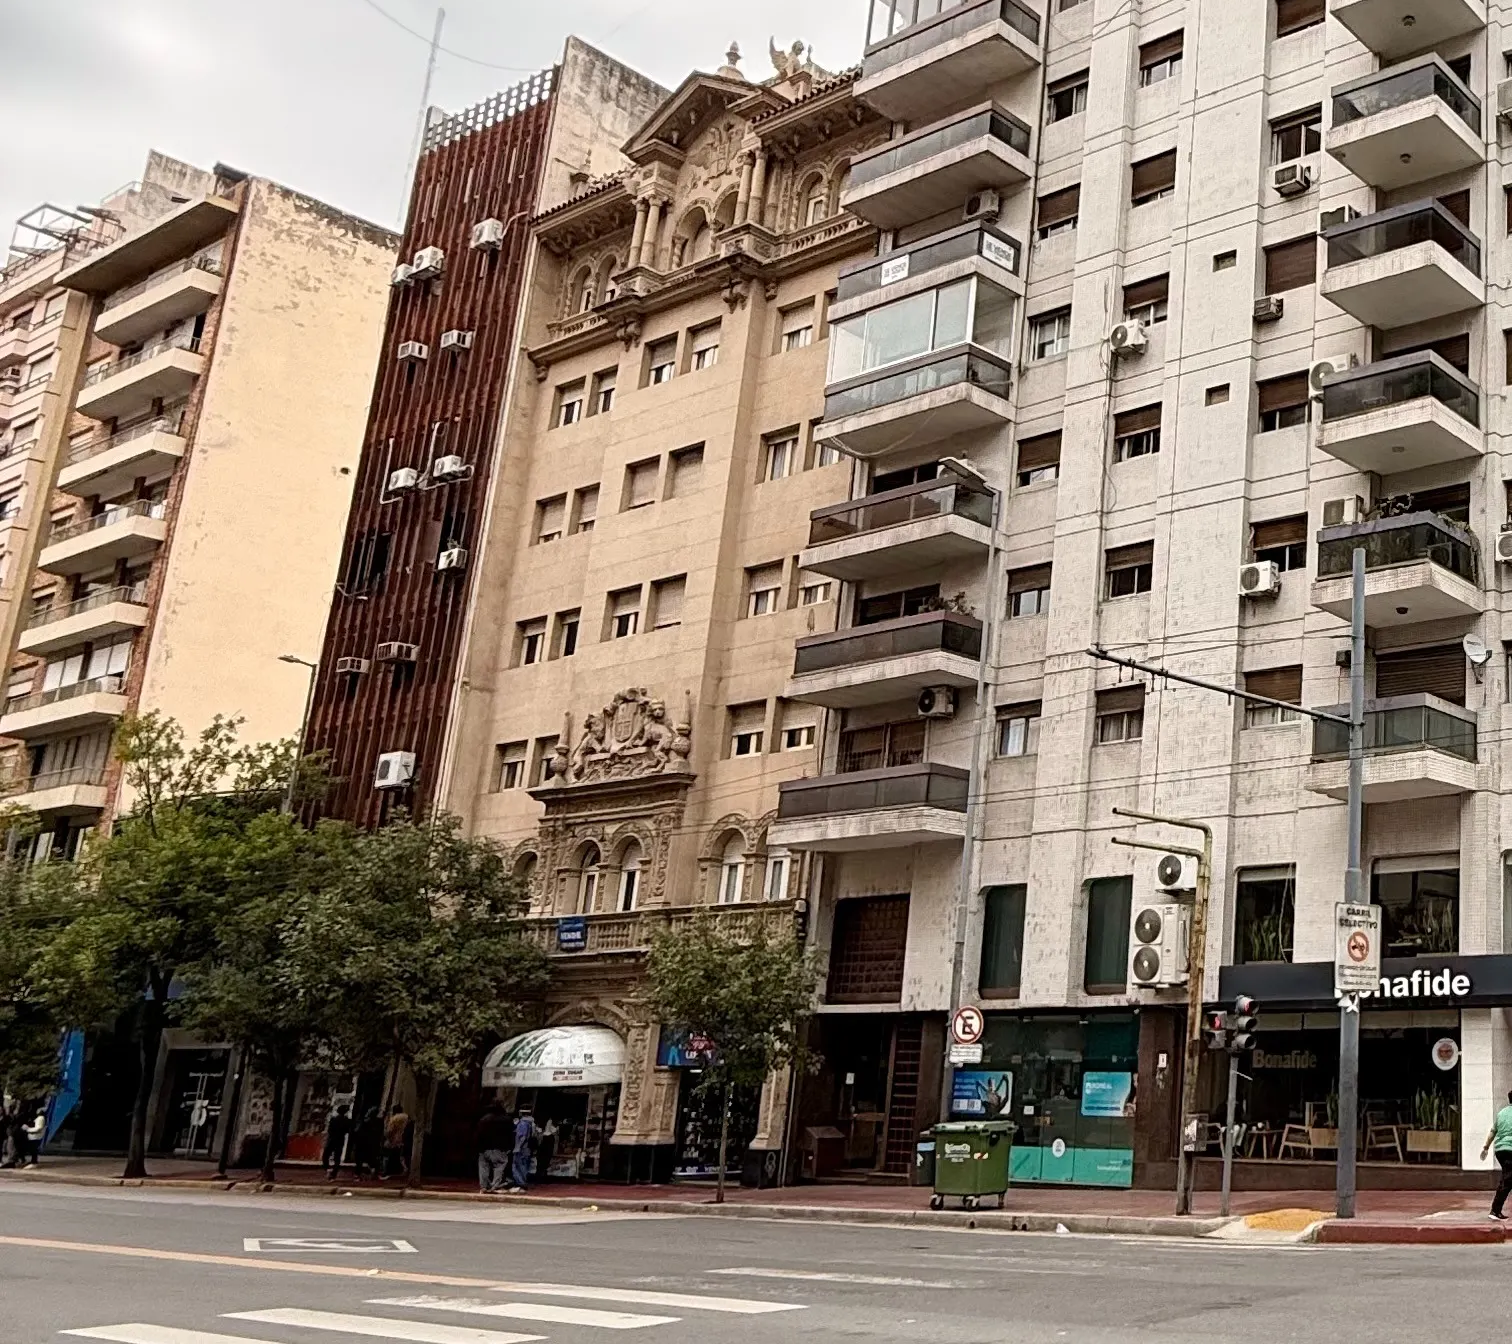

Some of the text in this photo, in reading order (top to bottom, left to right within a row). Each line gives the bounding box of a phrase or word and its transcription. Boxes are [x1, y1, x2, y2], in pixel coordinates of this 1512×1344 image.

[1346, 907, 1371, 918] CARRIL
[1339, 917, 1378, 930] SELECTIVO
[1334, 968, 1471, 999] nafide
[962, 1015, 975, 1035] E
[1252, 1049, 1317, 1069] Bonafide
